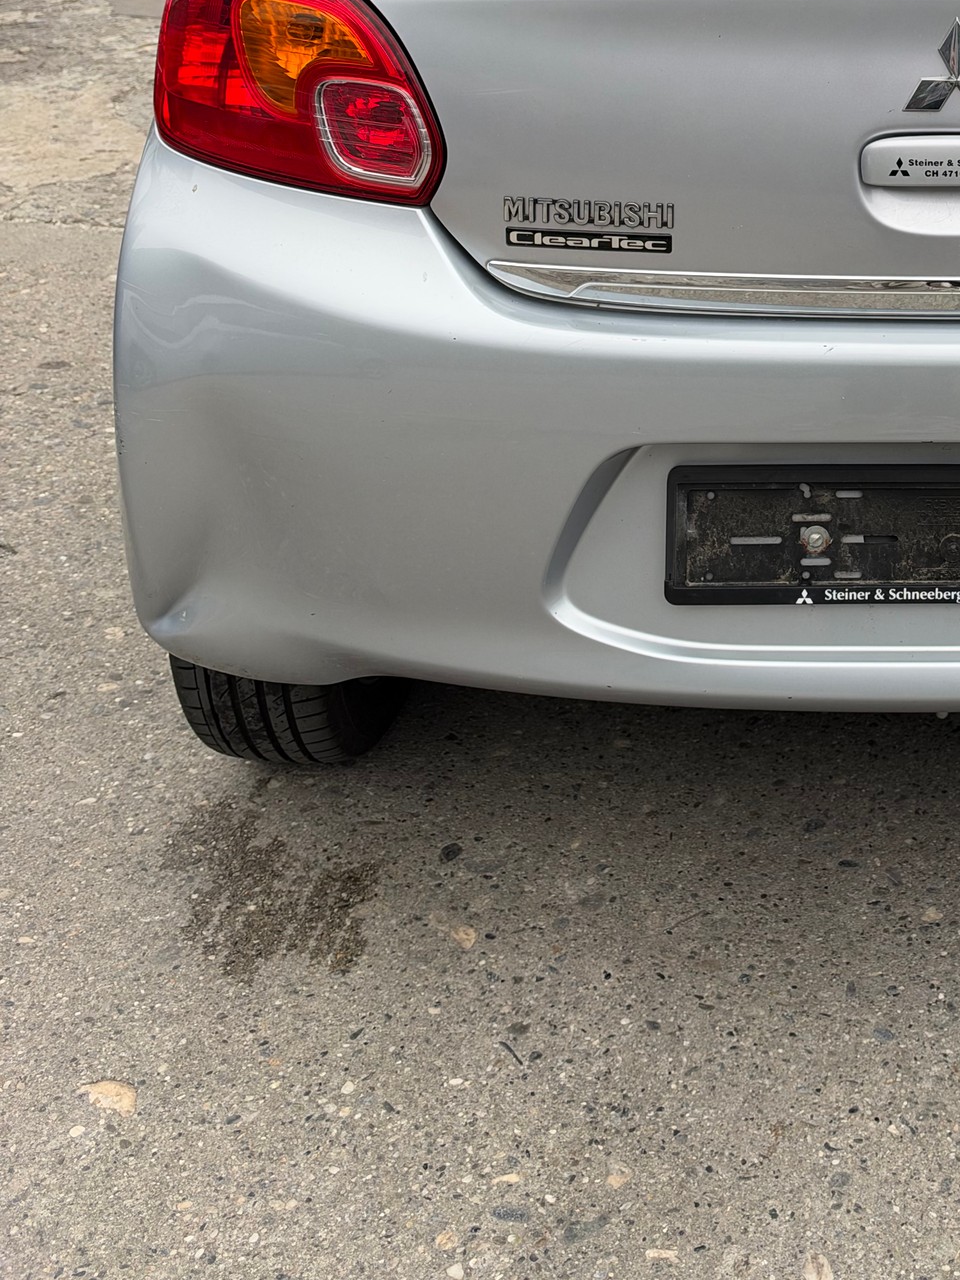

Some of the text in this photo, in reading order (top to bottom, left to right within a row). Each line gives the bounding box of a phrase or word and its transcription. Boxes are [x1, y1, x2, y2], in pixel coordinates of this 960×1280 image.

[908, 158, 944, 167] Steiner
[946, 158, 954, 167] &
[924, 170, 938, 178] CH
[503, 196, 675, 229] MITSUBISHI
[509, 230, 668, 251] ClearTec
[824, 588, 871, 601] Steiner
[874, 588, 885, 601] &
